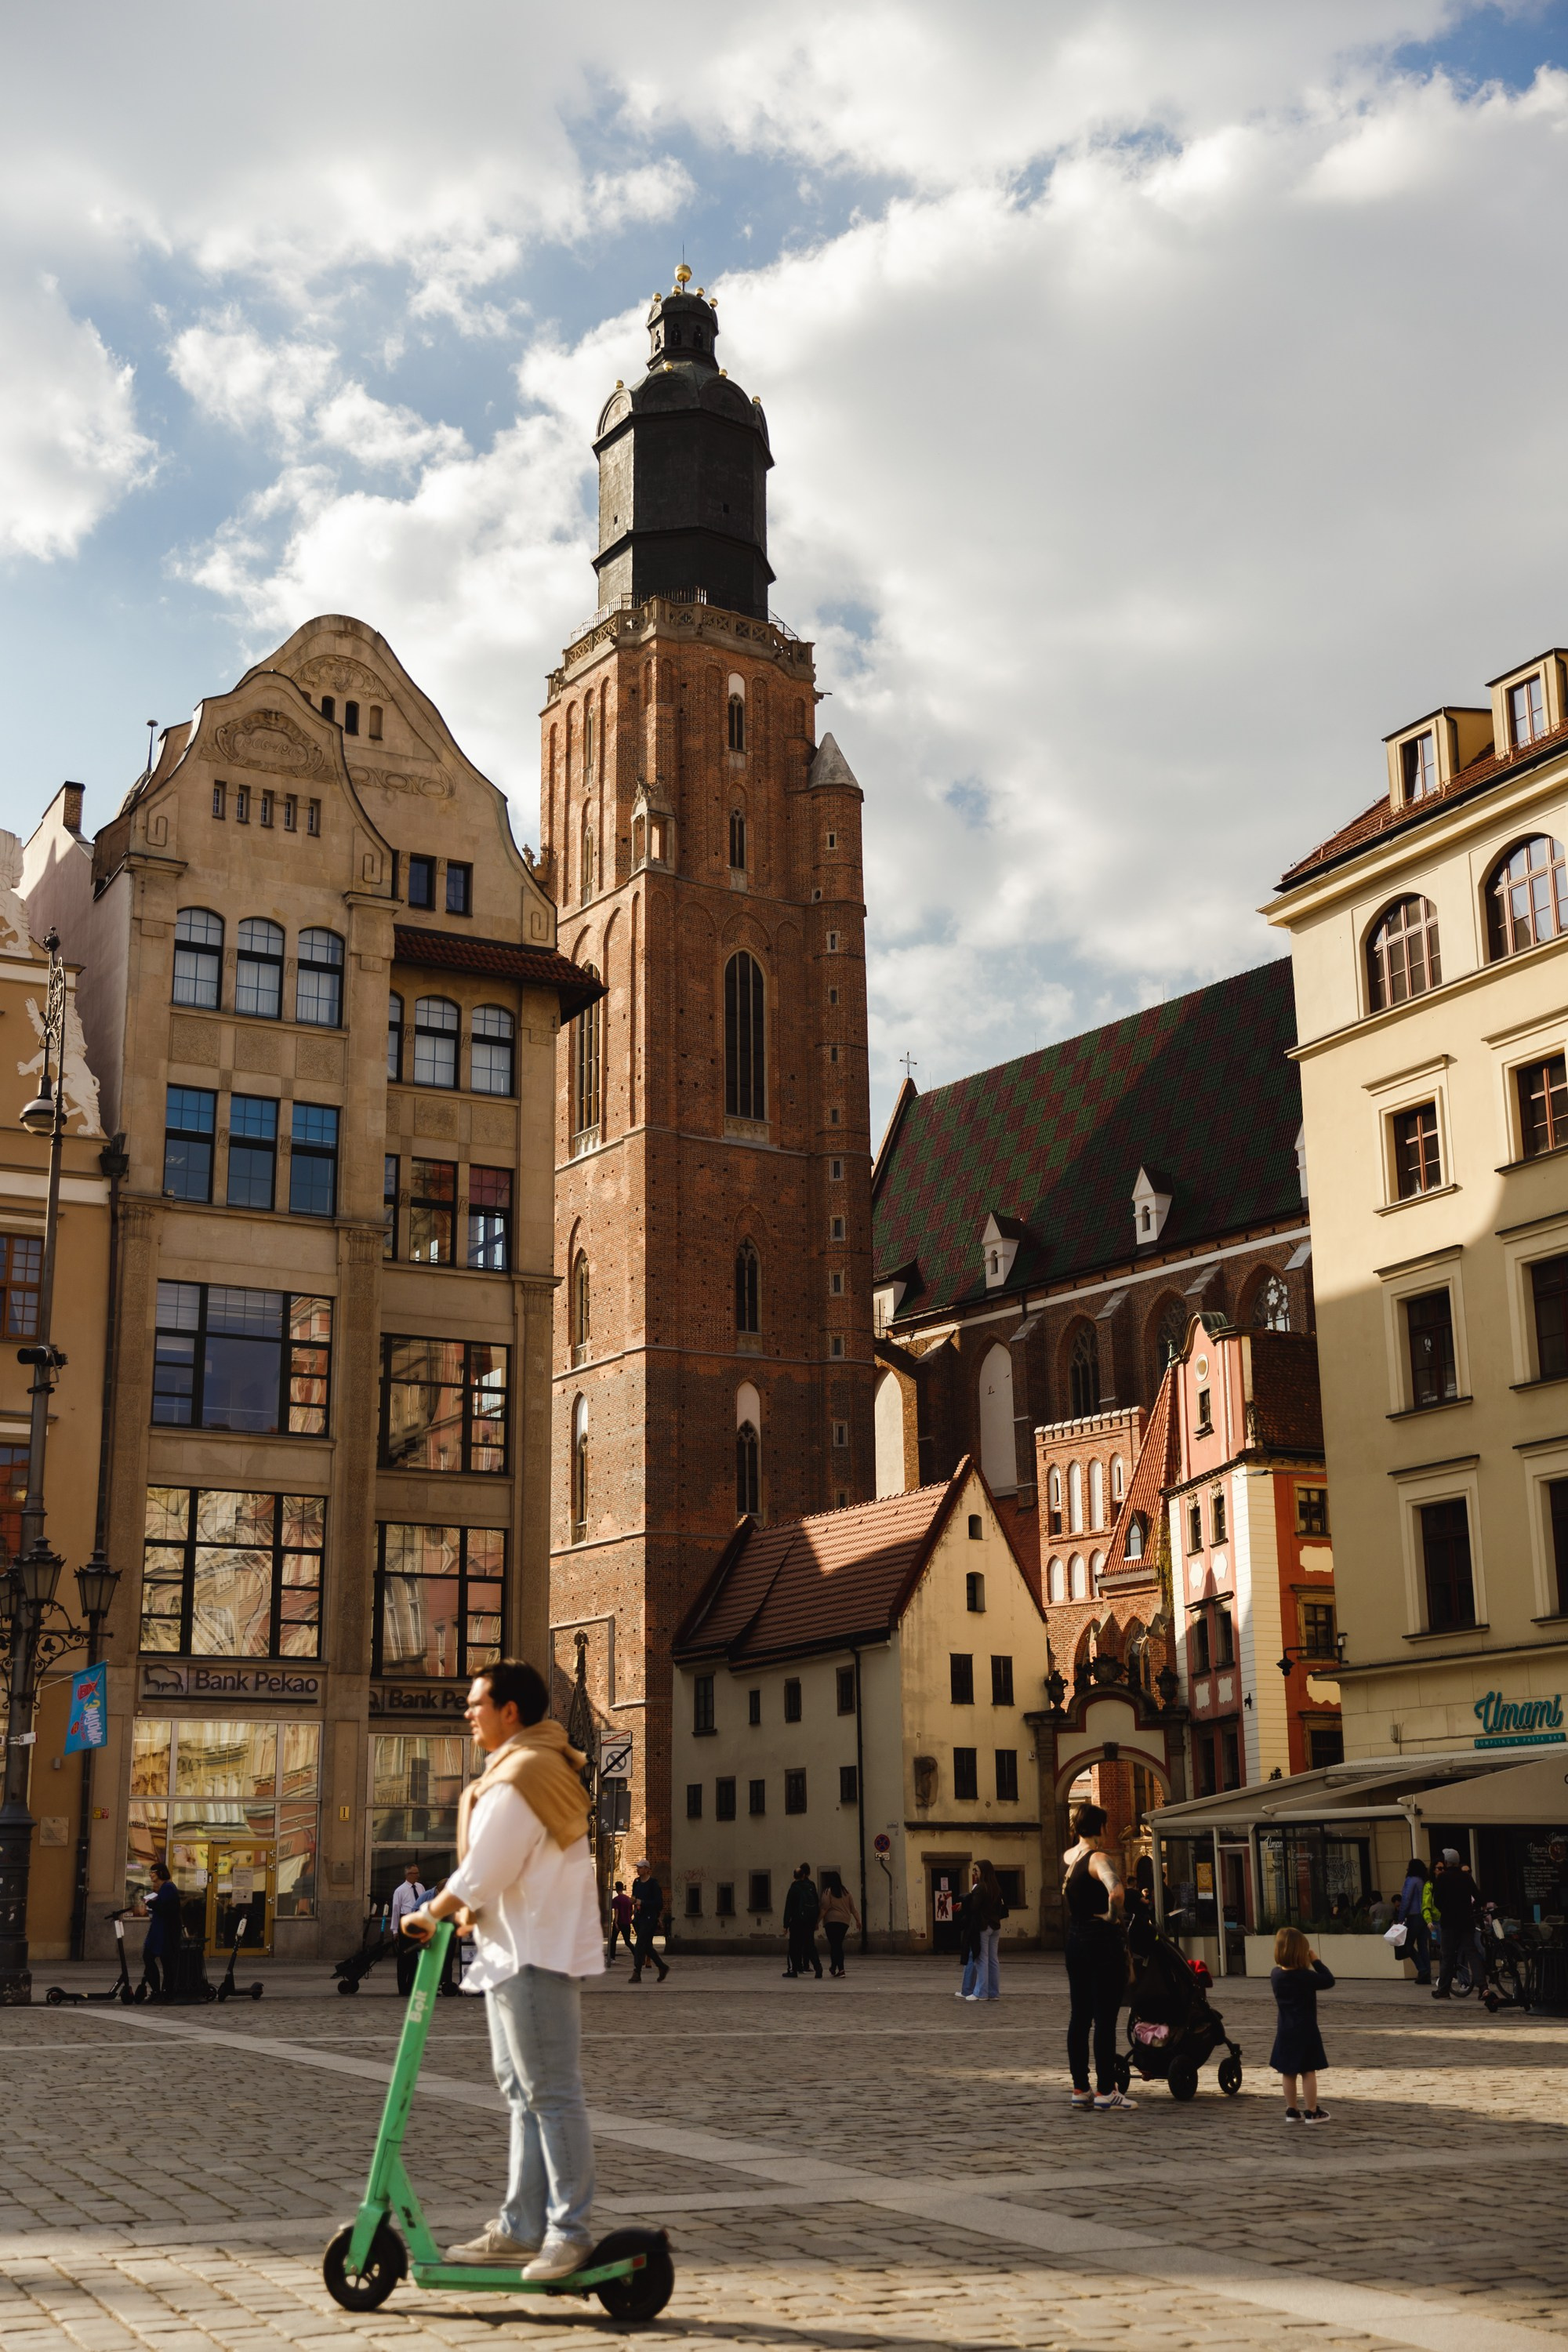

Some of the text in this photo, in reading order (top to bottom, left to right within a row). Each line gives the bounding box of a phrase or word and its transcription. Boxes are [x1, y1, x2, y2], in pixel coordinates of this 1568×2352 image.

[196, 1669, 318, 1693] Bank Pekao
[389, 1688, 437, 1708] Bank
[1475, 1691, 1563, 1733] Umami
[408, 1990, 428, 2024] Bolt
